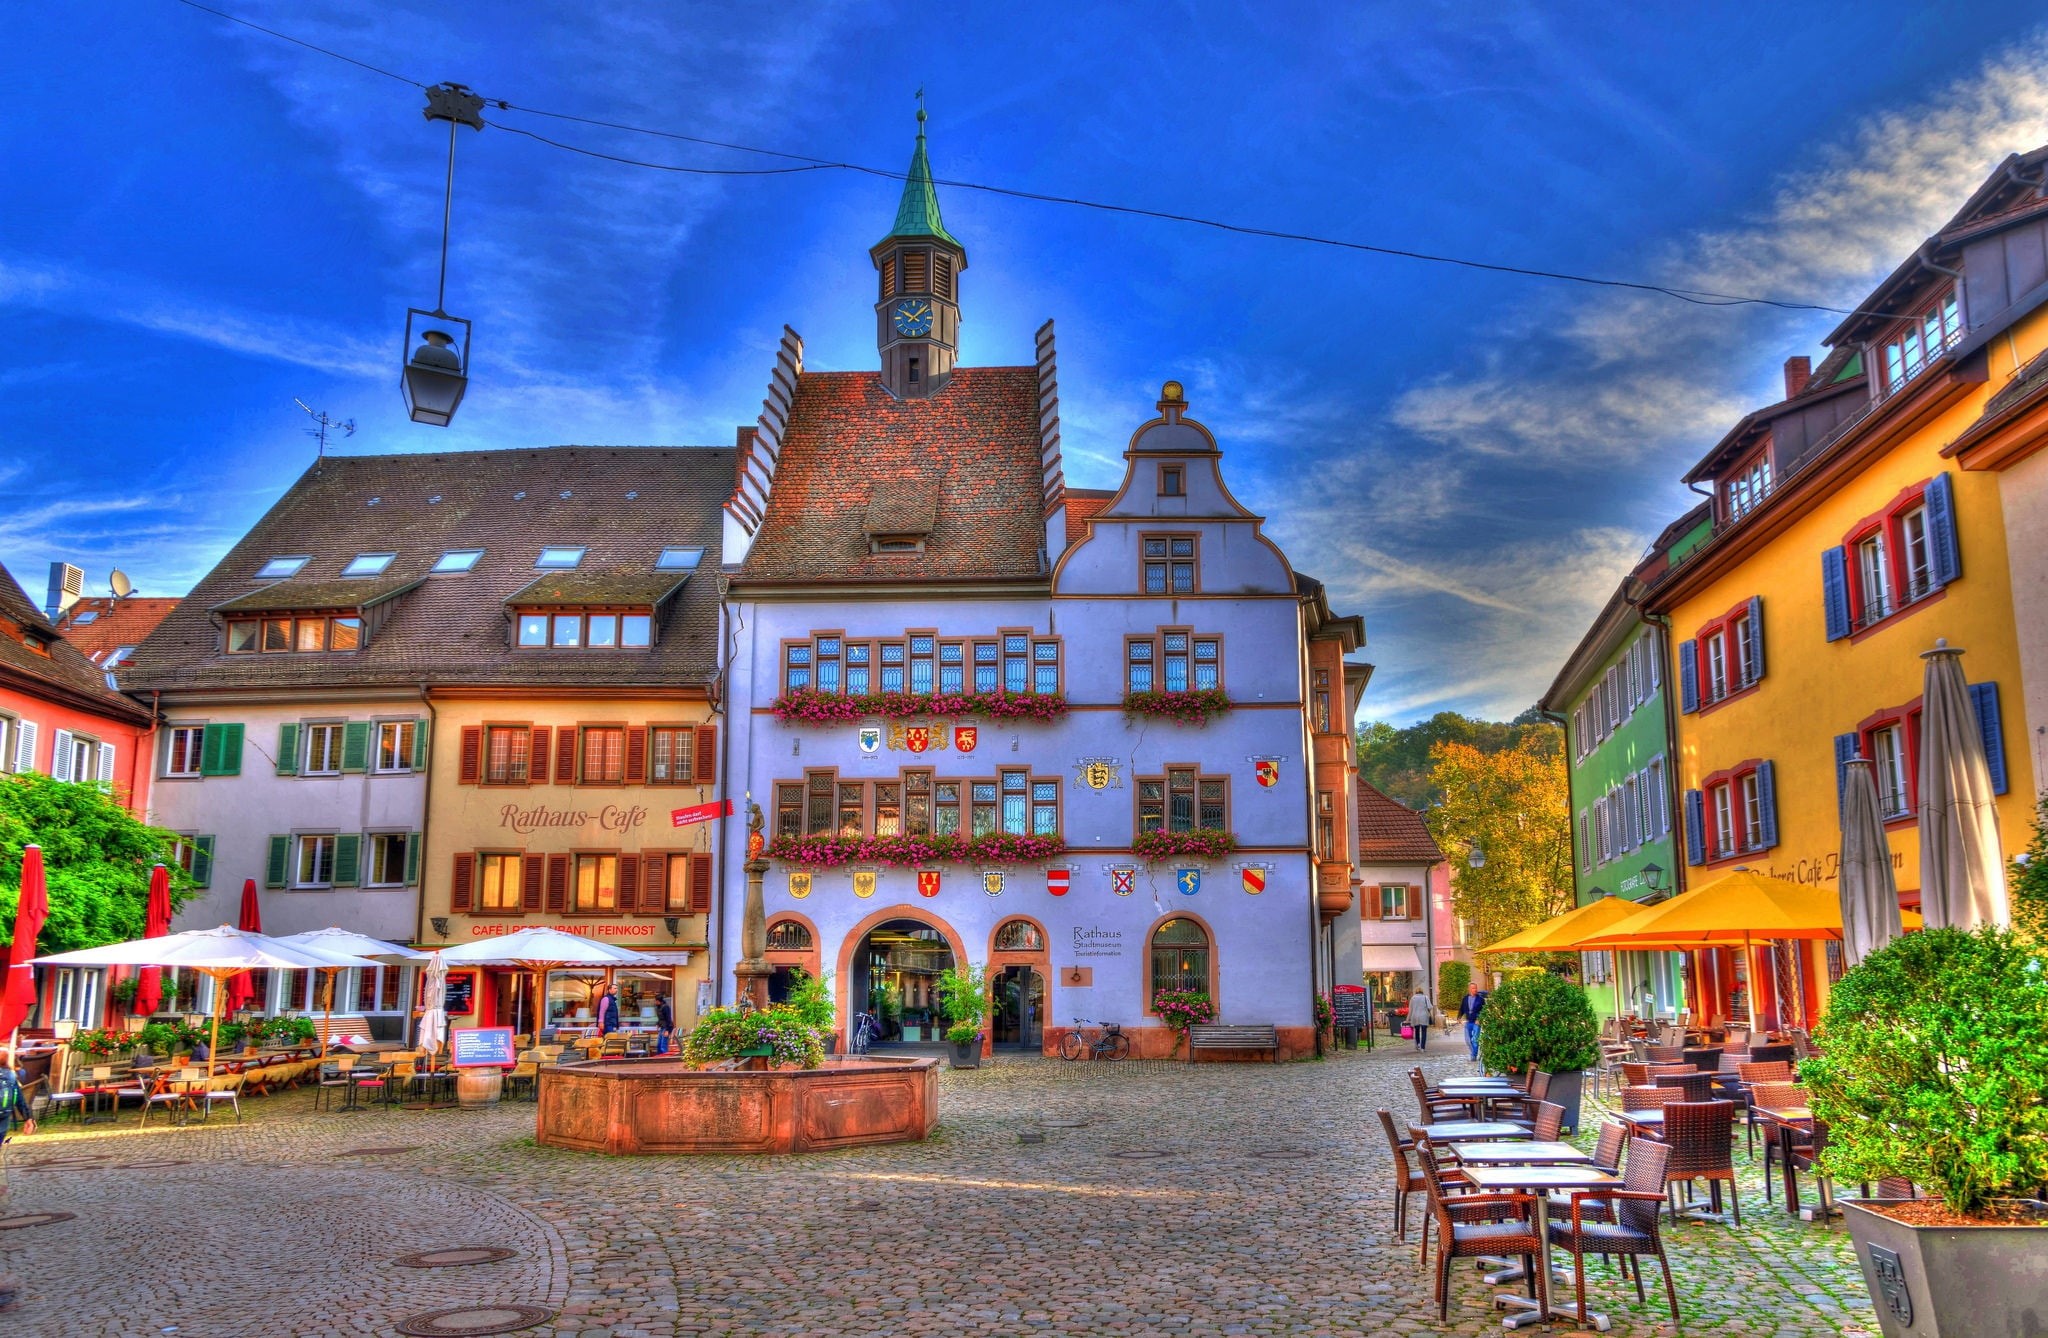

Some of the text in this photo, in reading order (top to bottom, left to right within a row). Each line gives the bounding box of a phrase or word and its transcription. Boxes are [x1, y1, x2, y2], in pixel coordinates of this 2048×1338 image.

[499, 804, 649, 834] Rathaus-Café
[1798, 859, 1822, 887] Café
[472, 924, 502, 936] CAFÉ
[598, 925, 656, 936] FEINKOST
[1073, 925, 1122, 940] Rathaus
